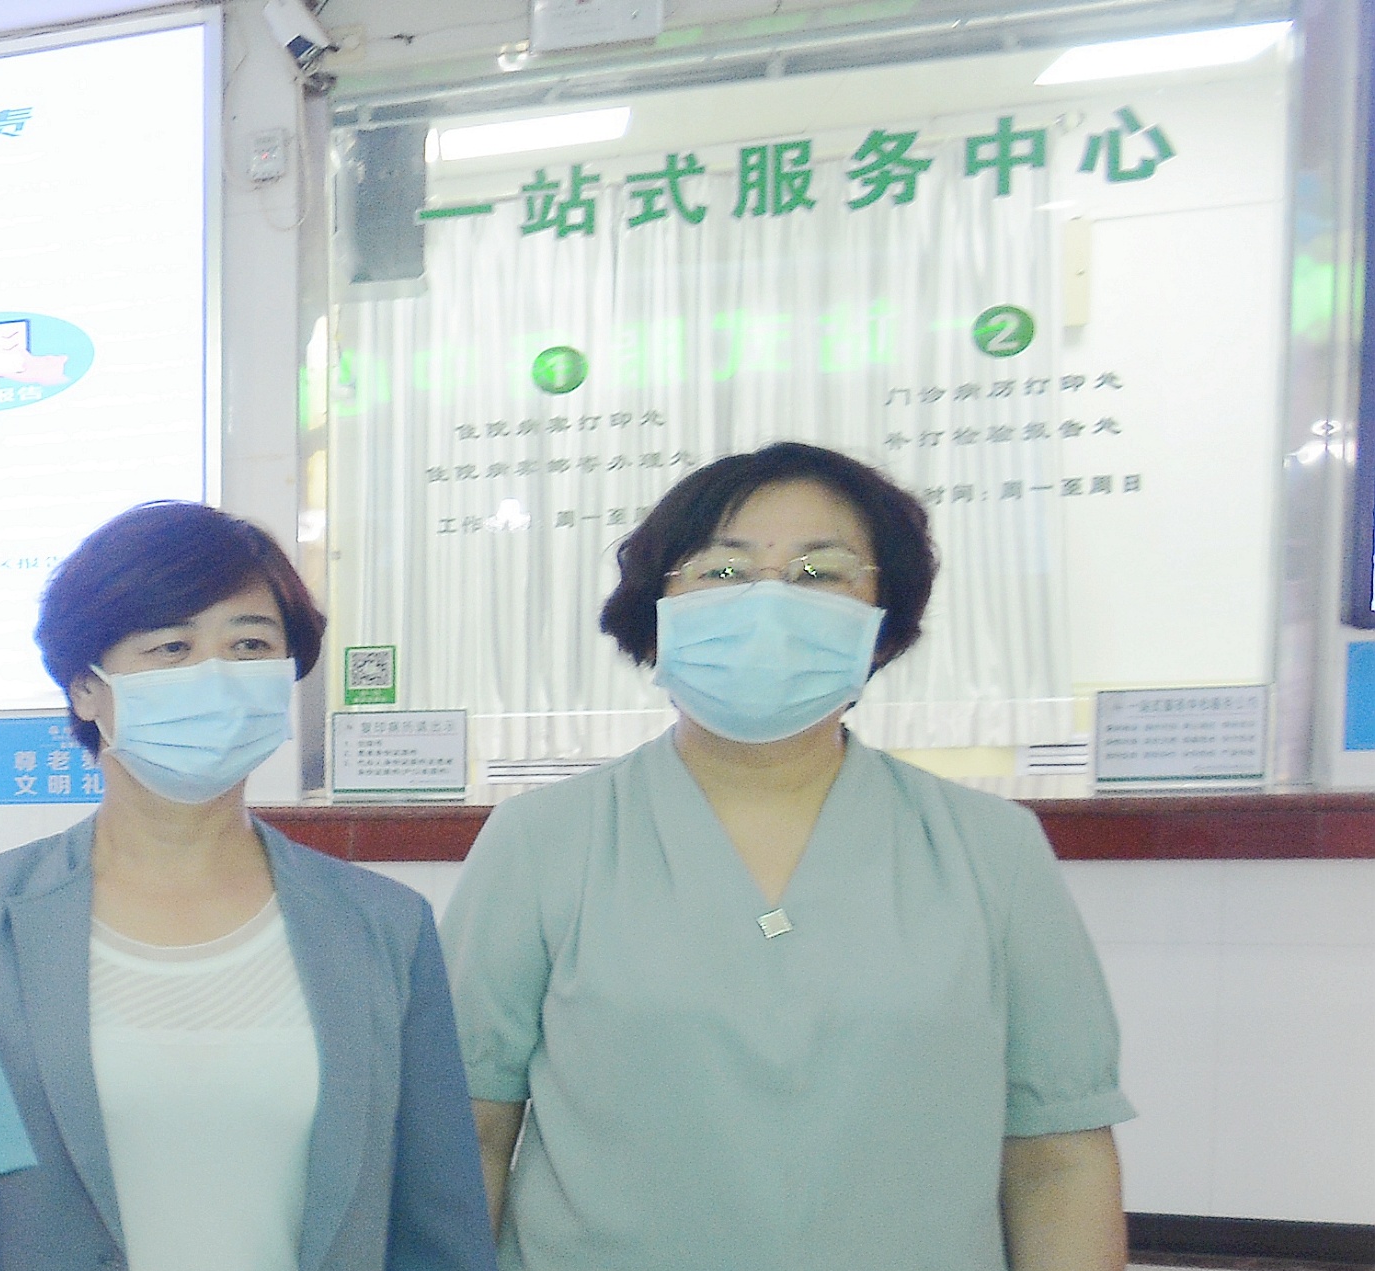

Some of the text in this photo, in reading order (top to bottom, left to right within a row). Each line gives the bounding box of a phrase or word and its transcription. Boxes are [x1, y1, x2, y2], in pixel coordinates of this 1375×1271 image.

[417, 103, 1177, 240] 一站式服务中心
[884, 371, 1123, 406] 门诊病历打印处
[455, 408, 667, 440] 住院病案打印处
